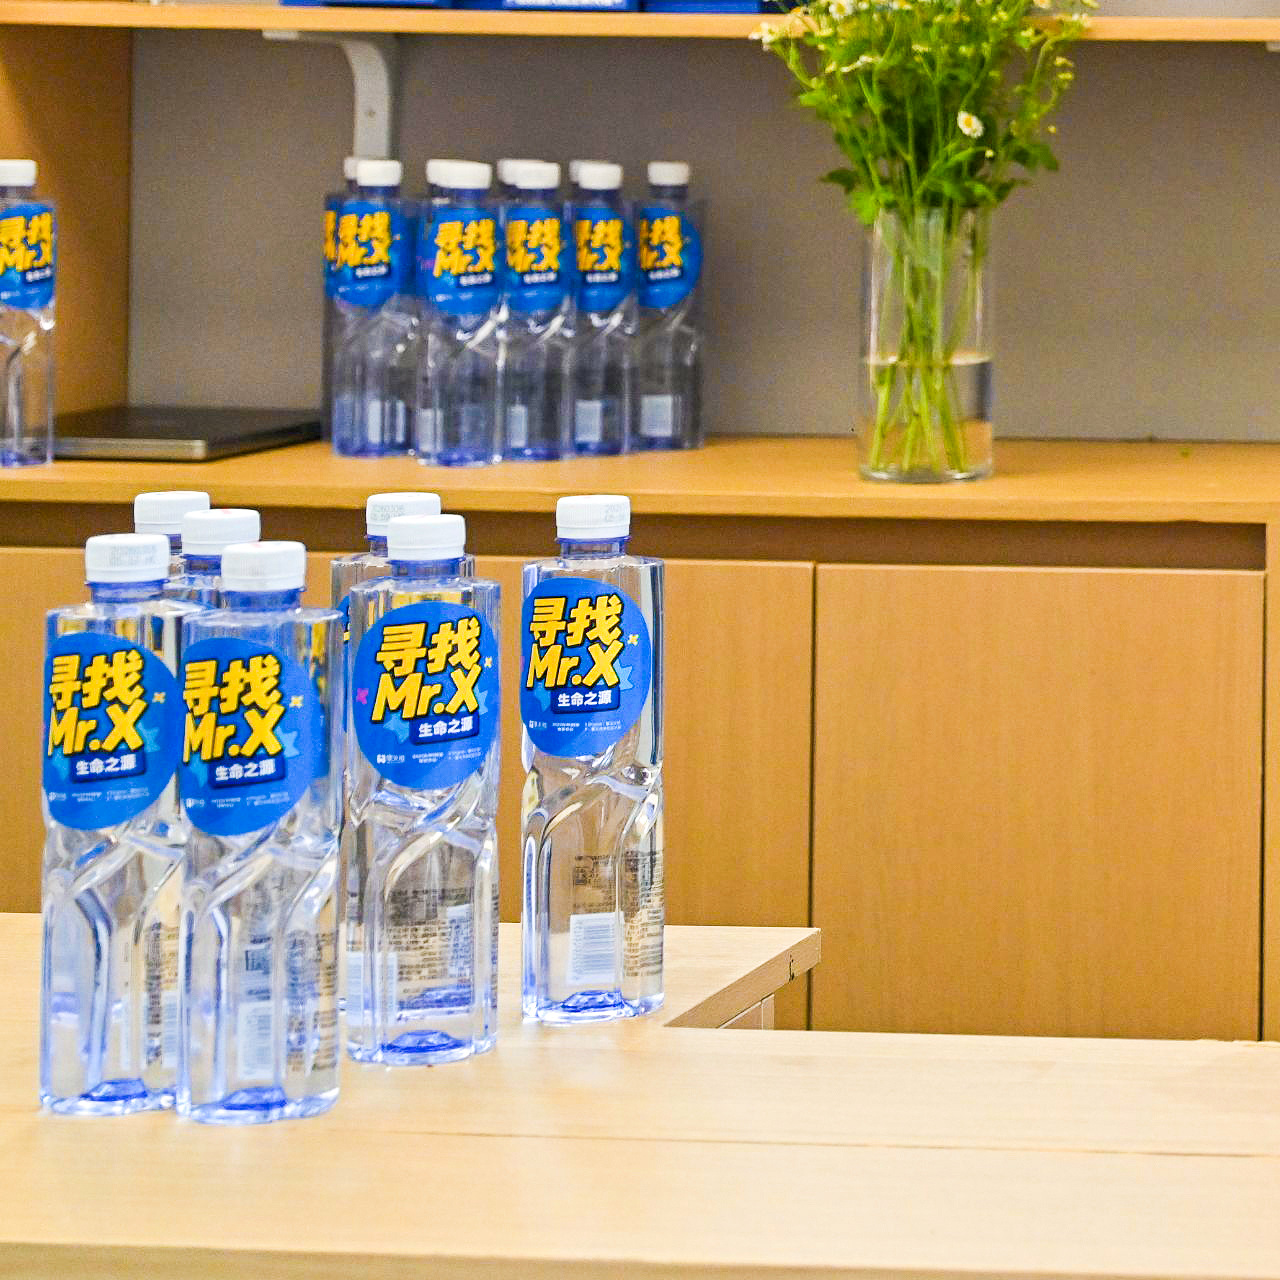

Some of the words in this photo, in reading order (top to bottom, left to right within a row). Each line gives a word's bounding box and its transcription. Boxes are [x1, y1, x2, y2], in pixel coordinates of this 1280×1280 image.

[375, 615, 482, 678] 寻找
[529, 594, 624, 647] 寻找
[49, 649, 145, 712] 寻找
[183, 654, 283, 717] 寻找
[525, 639, 625, 690] Mr.X
[370, 663, 483, 724] Mr.X
[557, 689, 613, 708] 生命之源
[47, 699, 148, 757] Mr.X
[182, 703, 286, 764] Mr.X
[418, 715, 474, 739] 生命之源
[75, 754, 137, 776] 生命之源
[215, 758, 276, 782] 生命之源
